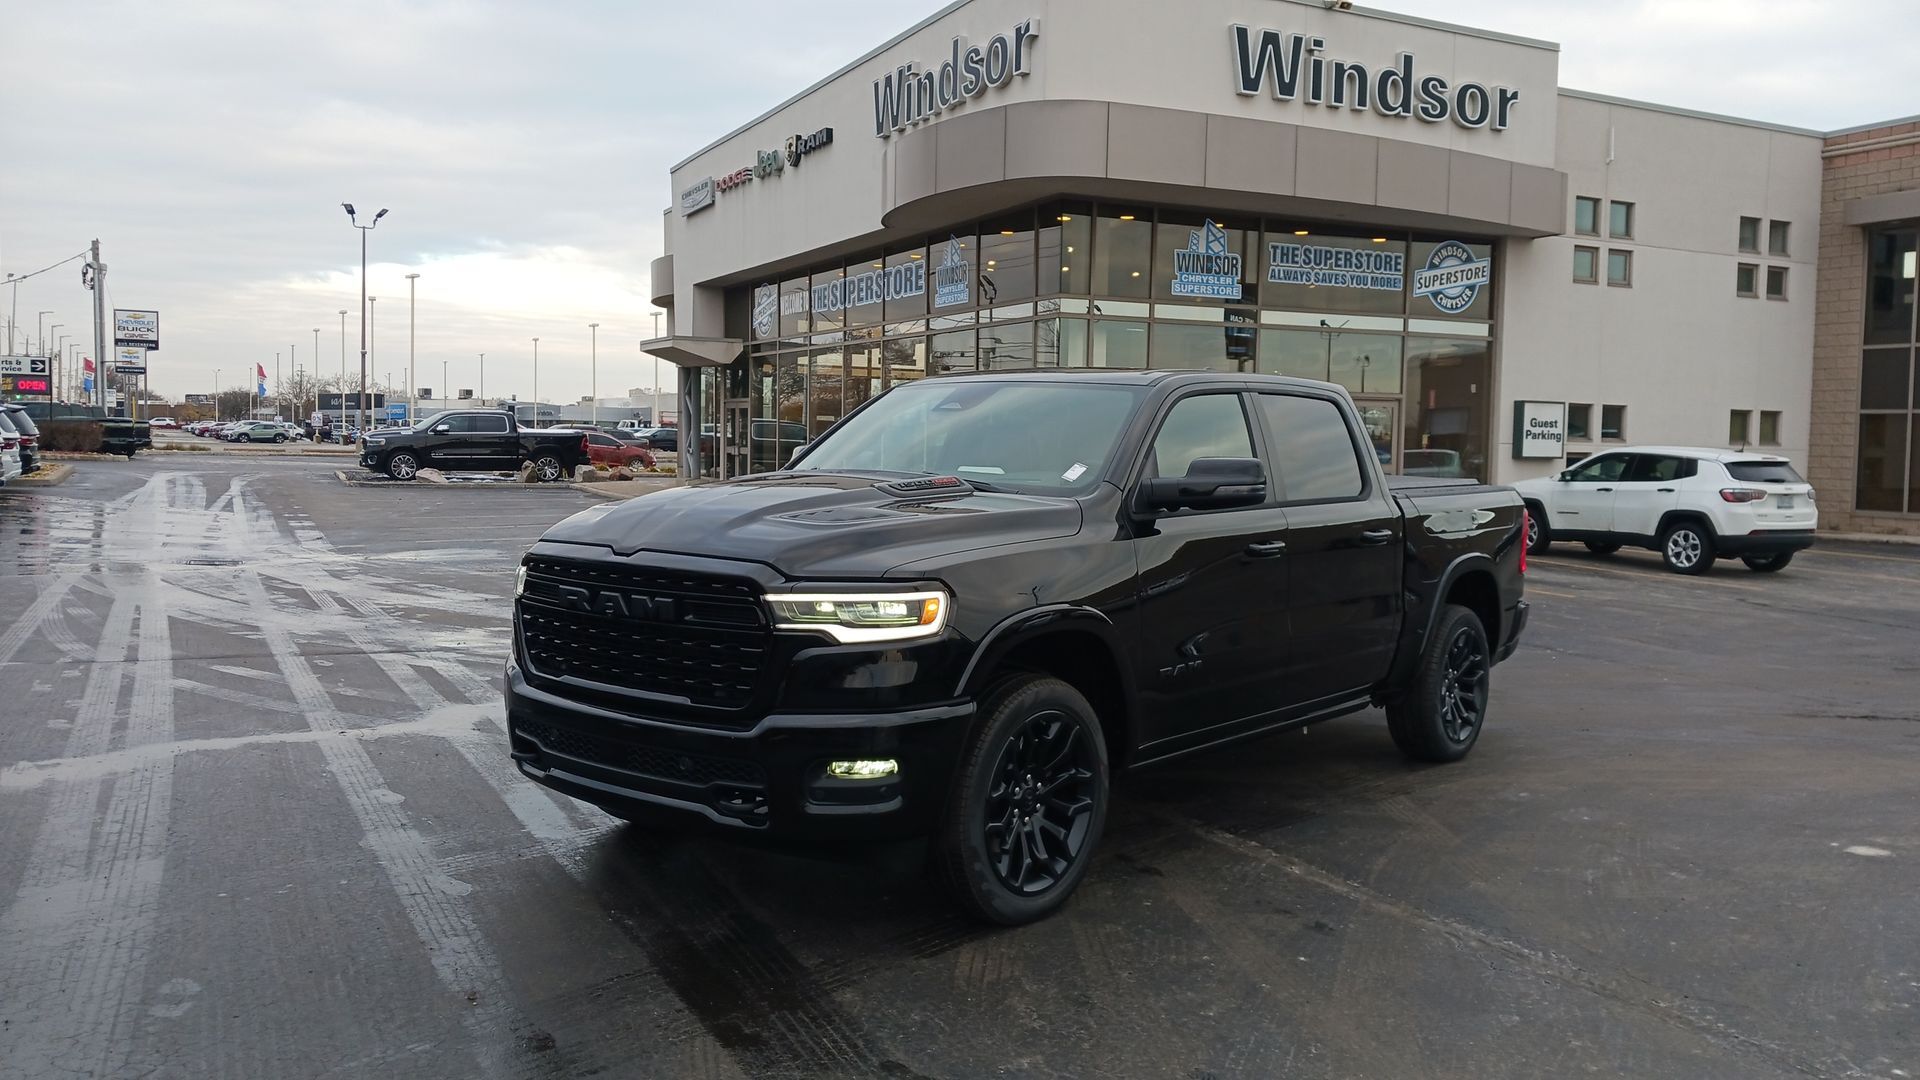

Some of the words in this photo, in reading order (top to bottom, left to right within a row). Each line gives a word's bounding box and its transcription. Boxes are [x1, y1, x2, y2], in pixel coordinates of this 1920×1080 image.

[872, 17, 1039, 139] Windsor
[1230, 23, 1520, 131] Windsor
[798, 128, 828, 154] RAM
[753, 149, 782, 179] Jeep
[715, 166, 748, 193] DODGE
[681, 180, 709, 201] CHRYSLER
[1176, 253, 1240, 276] WINDSOR
[1269, 244, 1300, 266] THE
[1302, 247, 1403, 273] SUPERSTORE
[1433, 246, 1468, 266] WINDSOR
[937, 264, 968, 288] WINDSOR
[1181, 274, 1233, 285] CHRYSLER
[1269, 268, 1312, 284] ALWAYS
[1313, 271, 1347, 286] SAVES
[1348, 273, 1369, 287] YOU
[1370, 275, 1402, 289] MORE!
[1417, 265, 1487, 290] SUPERSTORE
[812, 286, 828, 312] THE
[830, 262, 924, 311] SUPERSTORE
[940, 283, 965, 294] CHRYSLER
[1174, 283, 1240, 296] SUPERSTORE
[936, 292, 968, 306] SUPERSTORE
[1437, 288, 1473, 309] CHRYSLER
[117, 325, 155, 333] BUICK
[17, 379, 47, 391] OPEN
[1530, 417, 1558, 428] Guest
[1525, 429, 1562, 443] Parking
[558, 584, 675, 621] RAM
